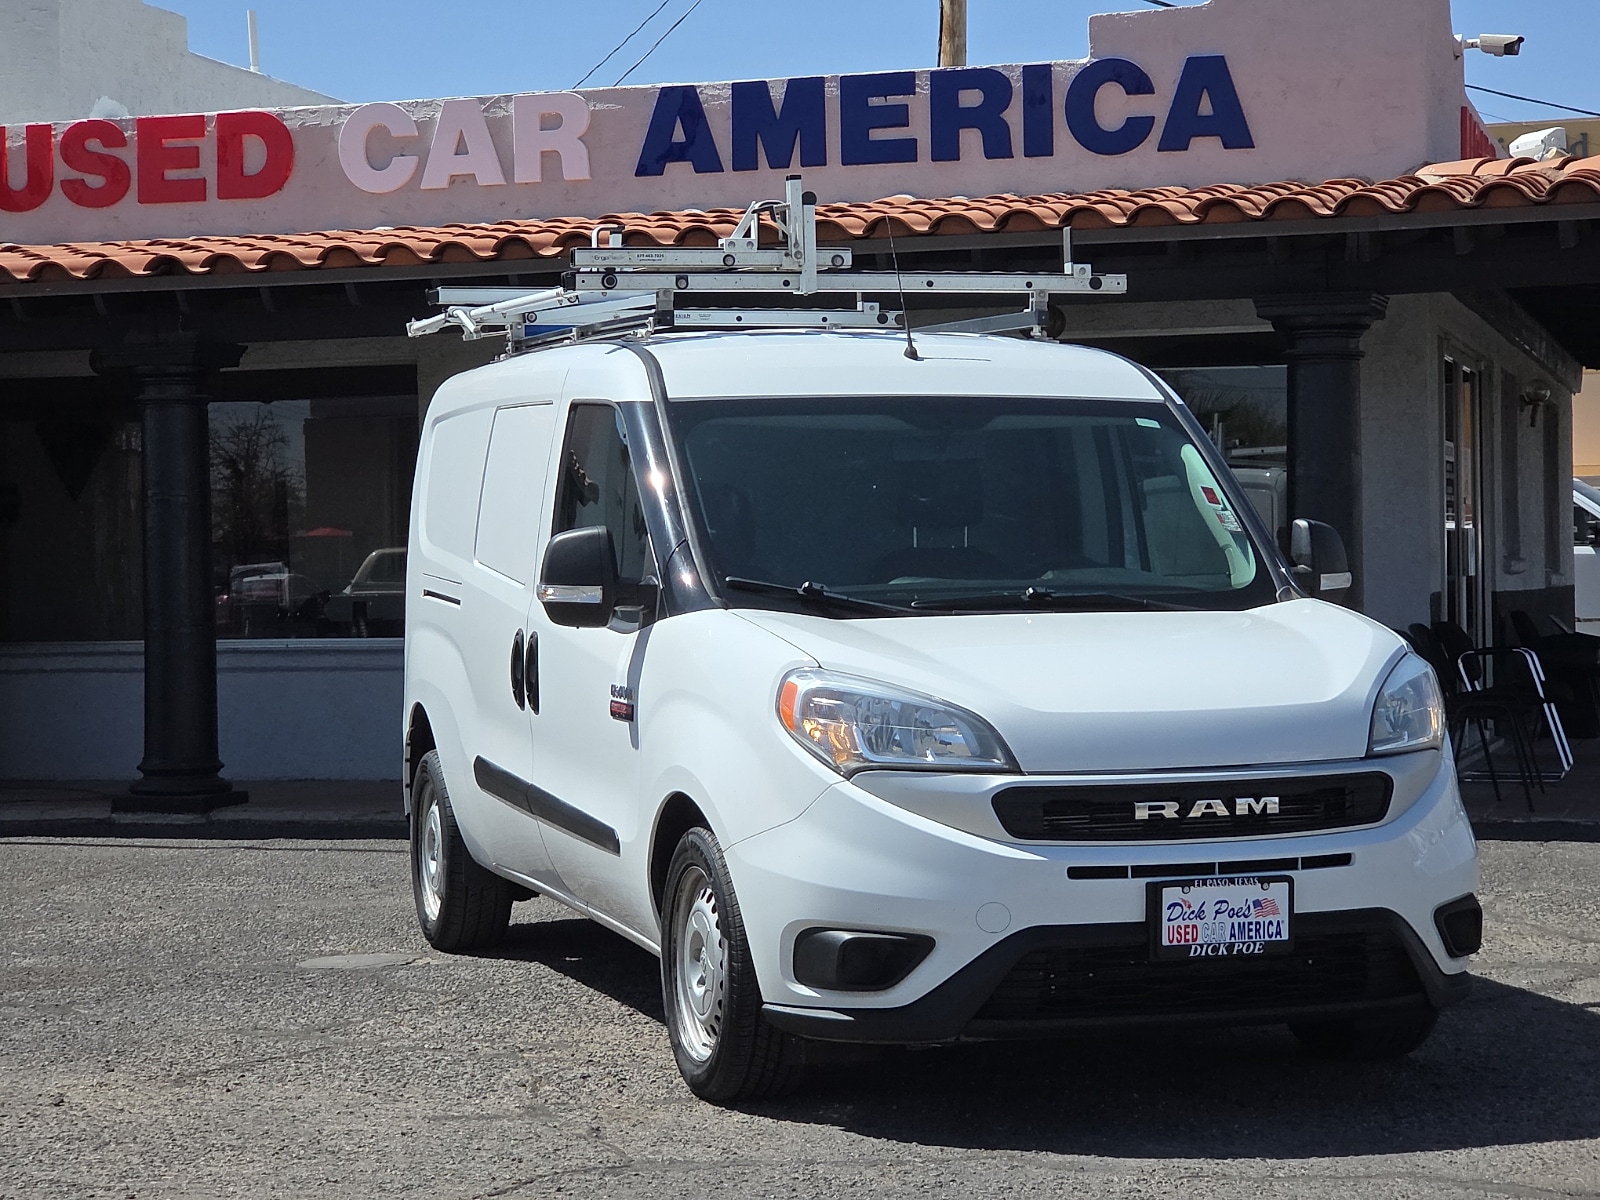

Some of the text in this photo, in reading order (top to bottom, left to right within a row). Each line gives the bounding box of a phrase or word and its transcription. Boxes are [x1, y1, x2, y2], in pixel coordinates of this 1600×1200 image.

[0, 55, 1255, 213] USED CAR AMERICA
[1134, 796, 1280, 820] RAM
[1234, 876, 1259, 886] TEXAS
[1166, 898, 1253, 922] Dick Poe's
[1167, 920, 1283, 944] USED CAR AMERICA
[1188, 941, 1265, 957] DICK POE
